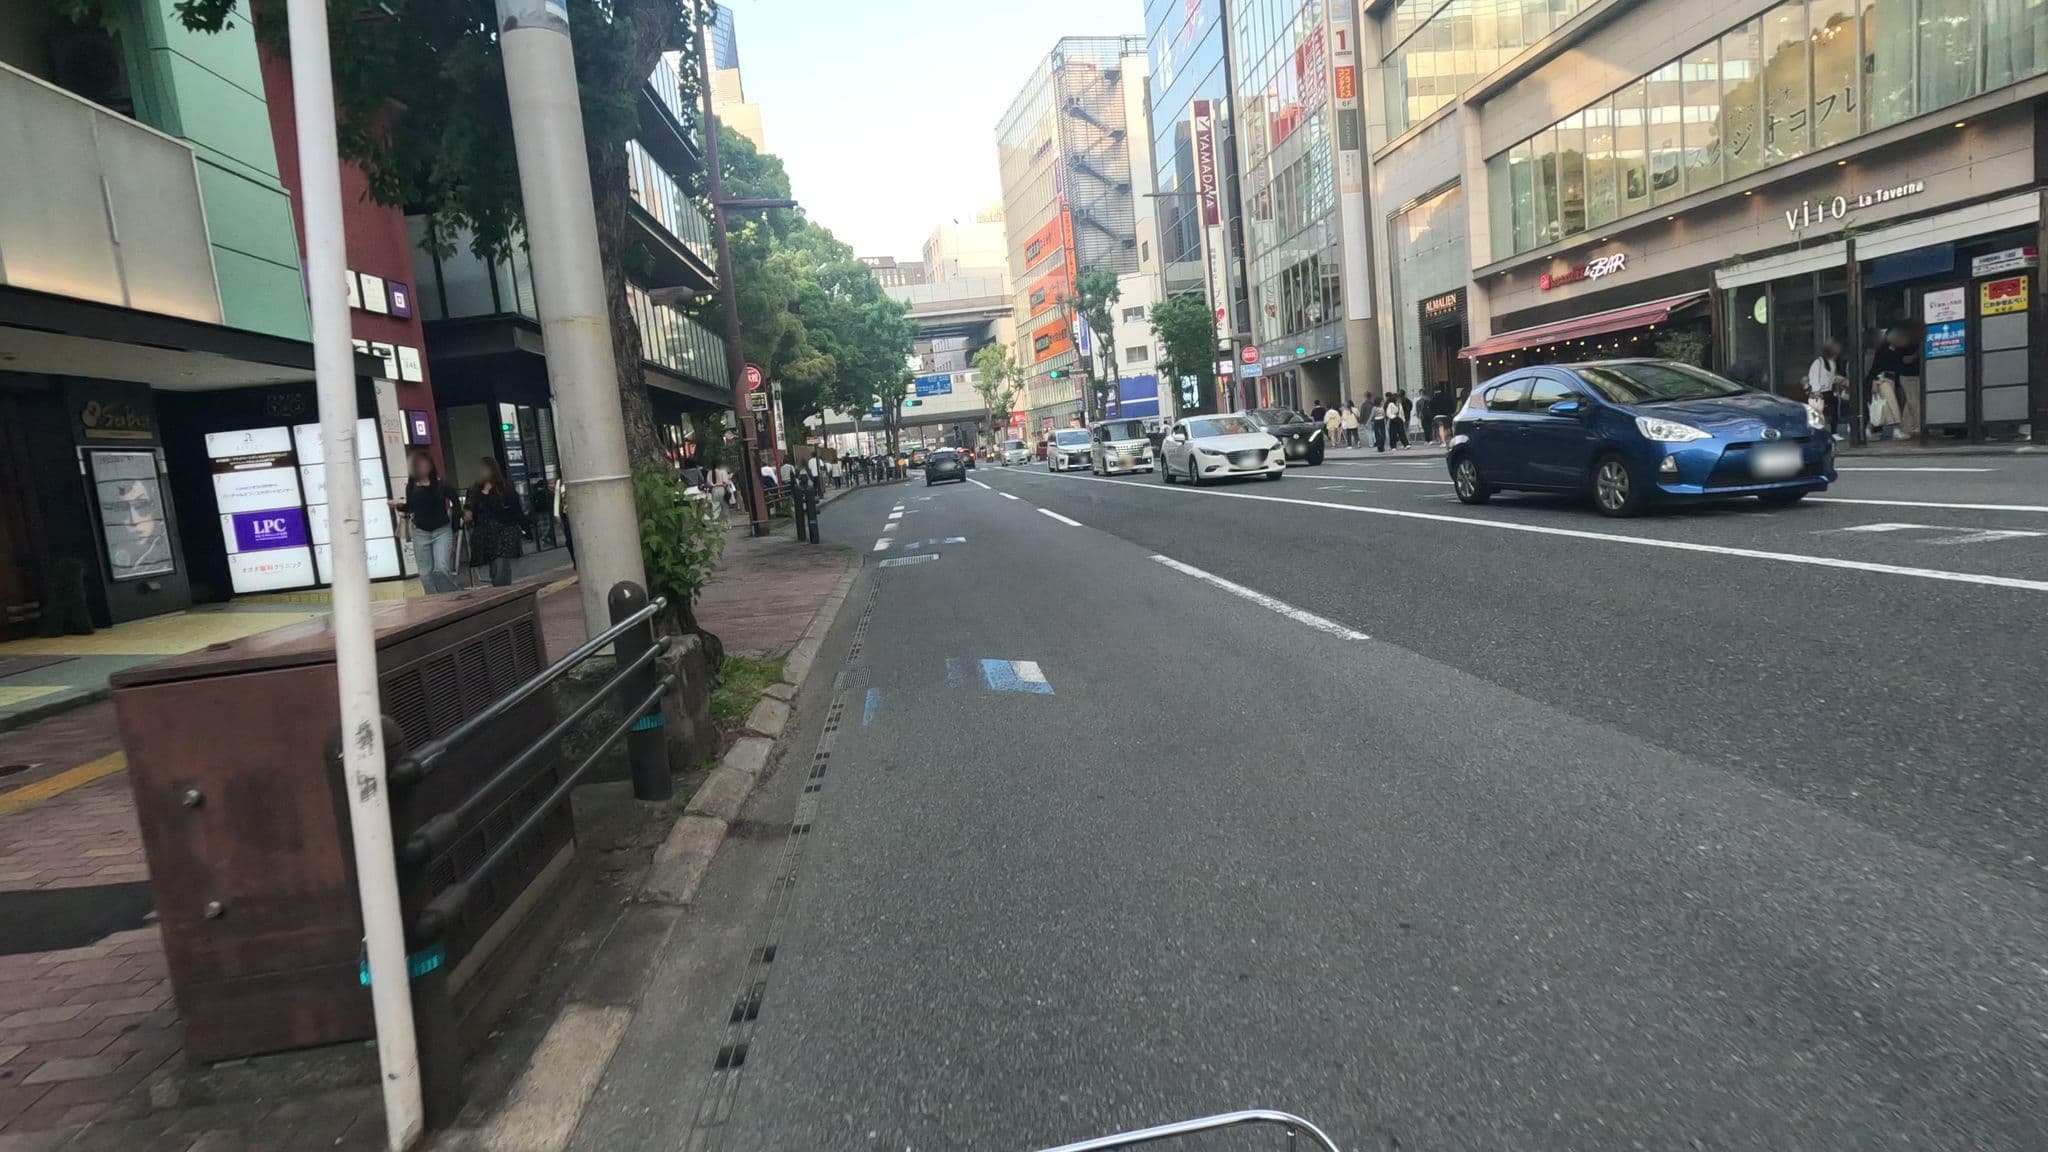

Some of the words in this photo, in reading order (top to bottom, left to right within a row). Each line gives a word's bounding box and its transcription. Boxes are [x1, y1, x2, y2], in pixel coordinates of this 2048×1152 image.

[1199, 132, 1217, 208] YAMADAYA
[1859, 194, 1873, 207] La
[1876, 181, 1924, 202] Taverna
[1589, 253, 1626, 281] BAR
[253, 518, 286, 534] LPC
